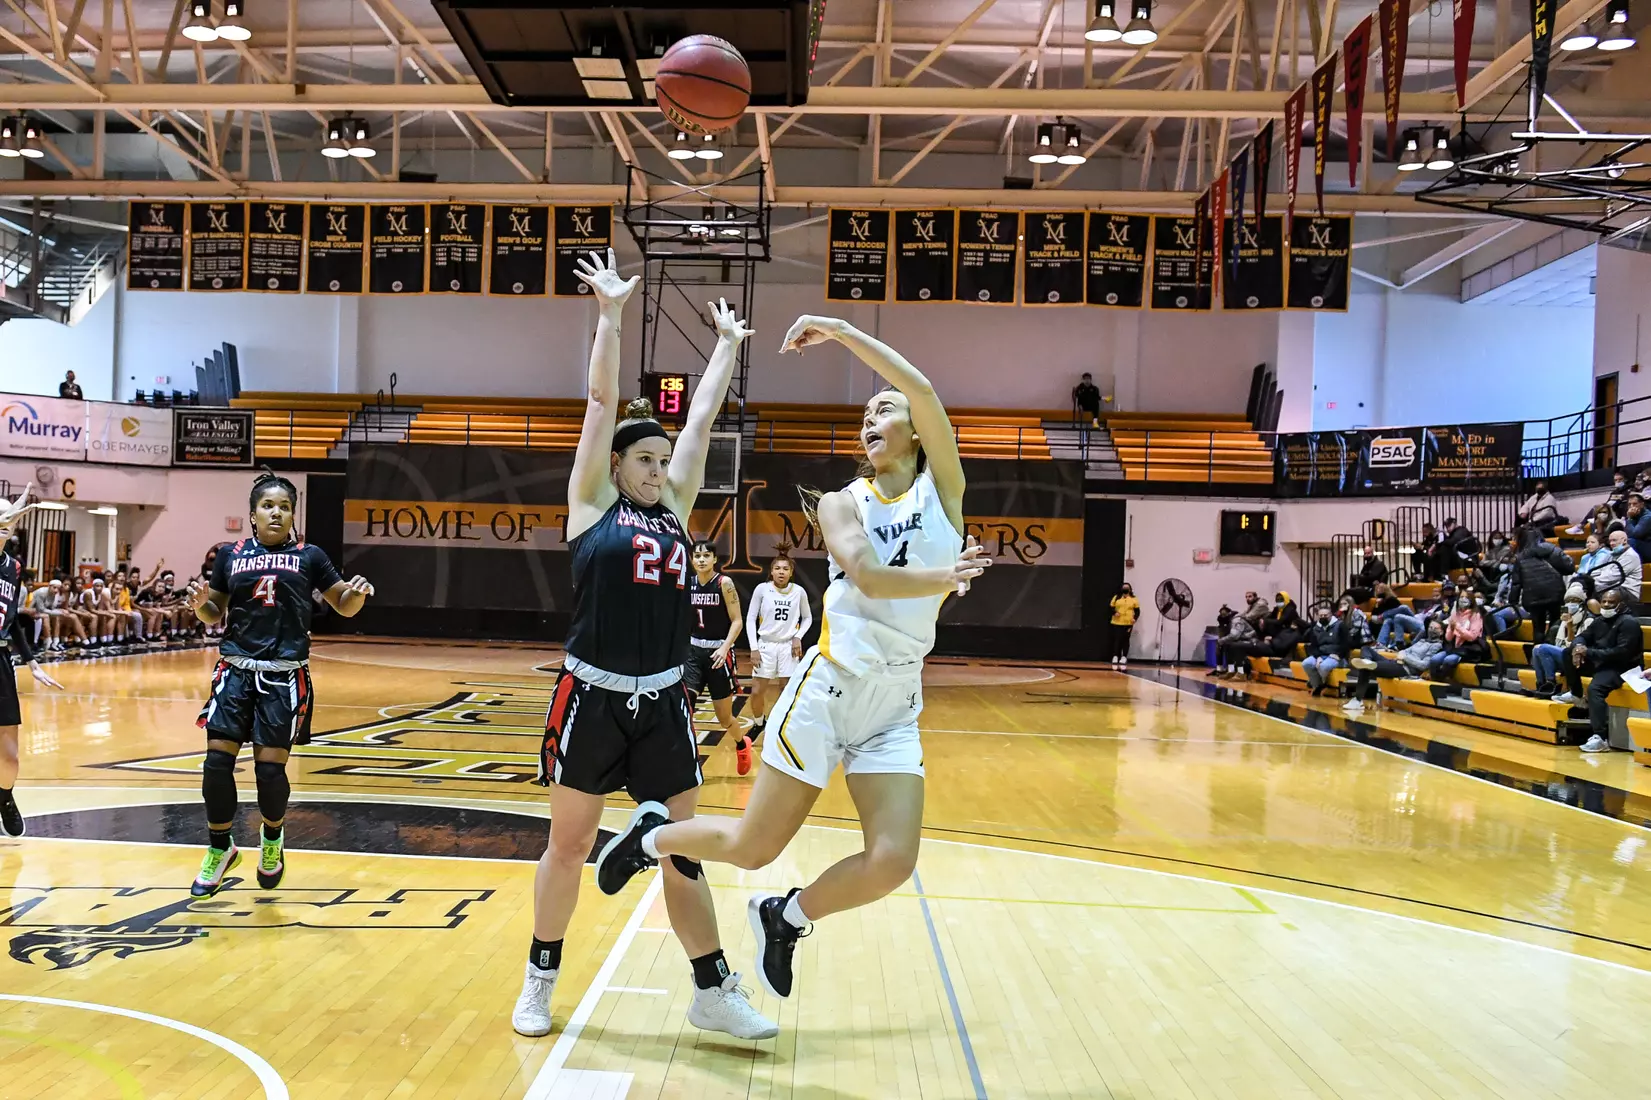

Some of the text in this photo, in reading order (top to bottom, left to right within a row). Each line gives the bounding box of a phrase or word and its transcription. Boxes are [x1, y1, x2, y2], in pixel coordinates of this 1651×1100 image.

[1349, 36, 1362, 109] IUP
[1285, 100, 1299, 204] EDINBORO
[440, 234, 473, 242] FOOTBALL
[832, 241, 855, 249] MEN'S
[1089, 251, 1113, 259] TRACK
[1099, 245, 1135, 253] WOMEN'S
[659, 391, 680, 413] 13
[9, 416, 82, 442] Murray
[187, 419, 241, 433] Iron Valley
[92, 440, 169, 455] OBERMAYER
[1484, 434, 1496, 444] in
[185, 445, 208, 453] Buying
[216, 446, 242, 454] Selling?
[1371, 446, 1413, 459] PSAC
[1438, 456, 1509, 468] MANAGEMENT
[62, 478, 75, 498] C
[363, 505, 481, 541] HOME
[490, 510, 541, 544] OF
[1372, 518, 1385, 540] D
[632, 533, 687, 590] 24
[887, 540, 909, 568] 4
[231, 554, 301, 576] MANSFIELD
[252, 574, 278, 607] 4
[774, 600, 792, 608] VILLE
[697, 608, 705, 628] 1
[774, 608, 790, 621] 25
